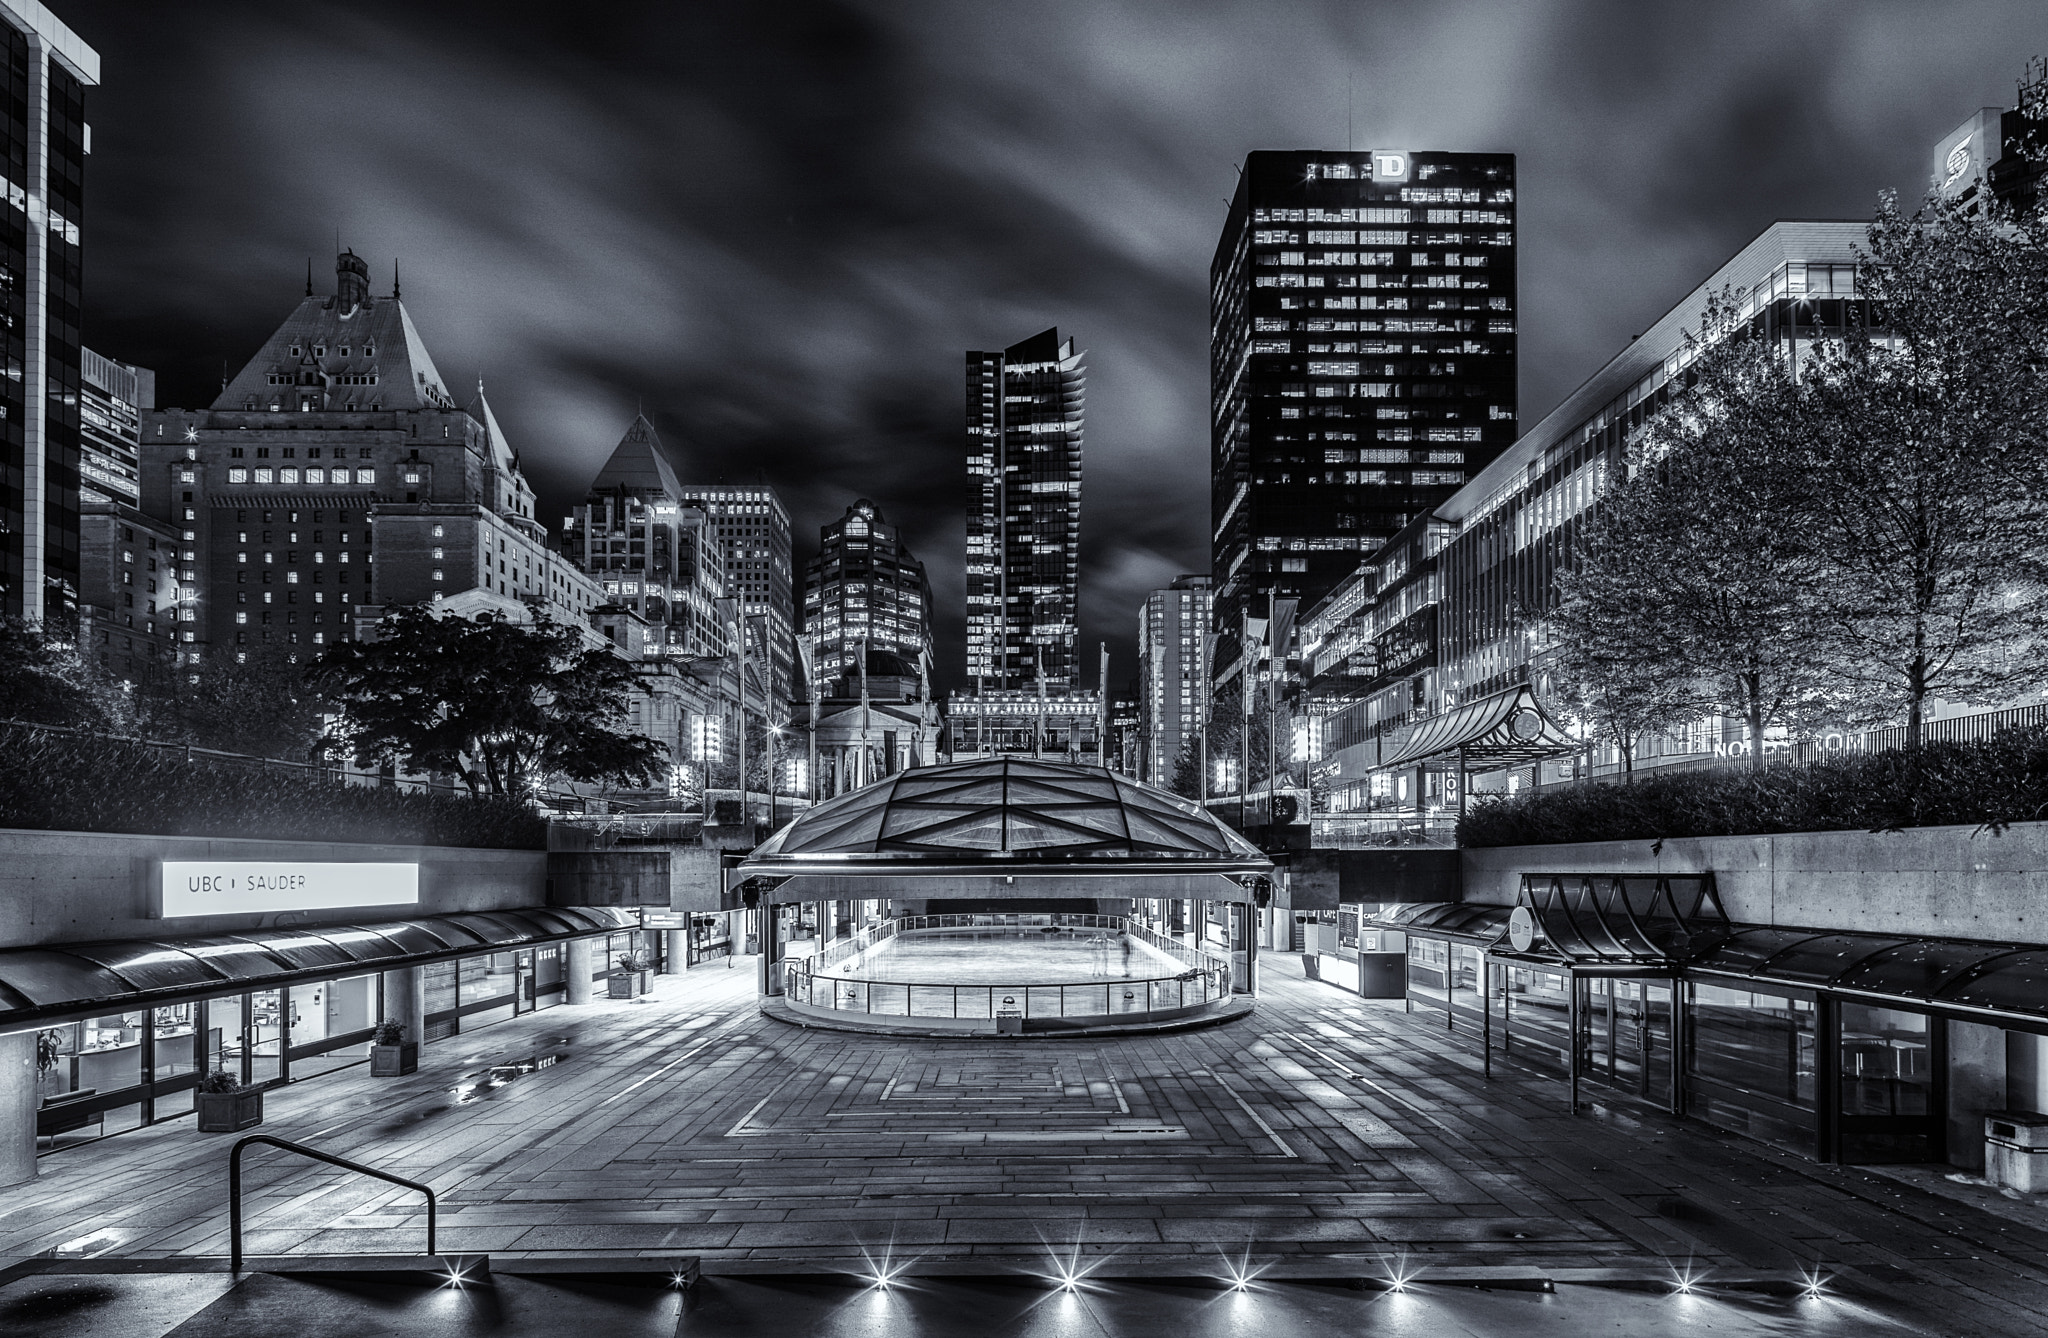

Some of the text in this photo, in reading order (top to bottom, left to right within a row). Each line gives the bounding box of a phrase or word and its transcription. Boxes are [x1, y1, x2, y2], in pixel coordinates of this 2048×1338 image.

[1375, 155, 1405, 176] TD
[188, 876, 222, 892] UBC
[247, 875, 306, 891] SAUDER
